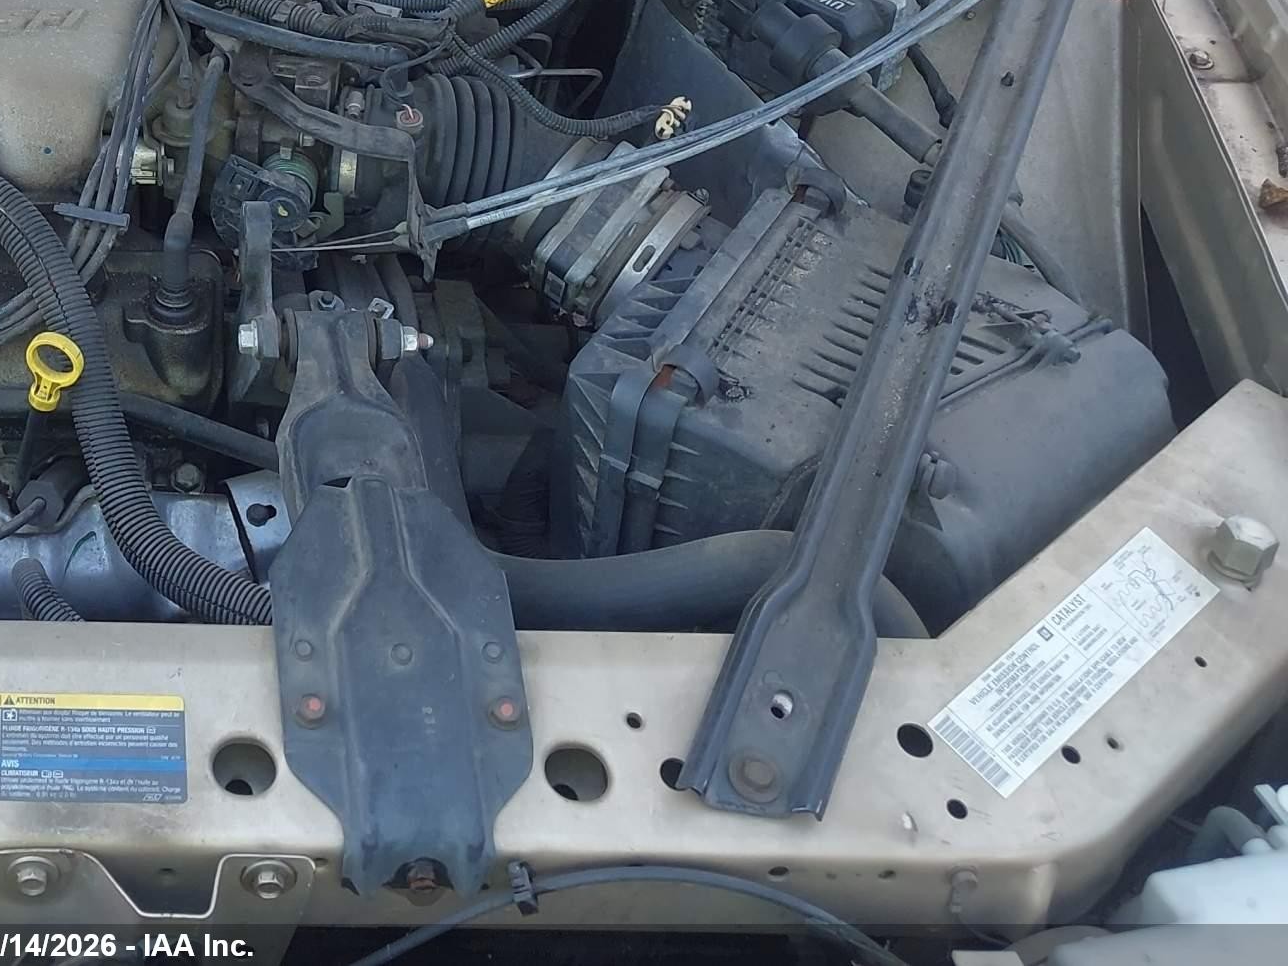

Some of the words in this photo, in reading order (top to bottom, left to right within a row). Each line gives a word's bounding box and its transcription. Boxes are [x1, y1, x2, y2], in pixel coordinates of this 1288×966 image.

[1050, 593, 1086, 626] CATALYST
[968, 683, 993, 706] VEHICLE
[990, 661, 1017, 686] EMISSION
[1014, 641, 1039, 664] CONTROL
[994, 661, 1031, 695] INFORMATION
[16, 697, 55, 705] ATTENTION
[2, 759, 20, 768] AVIS
